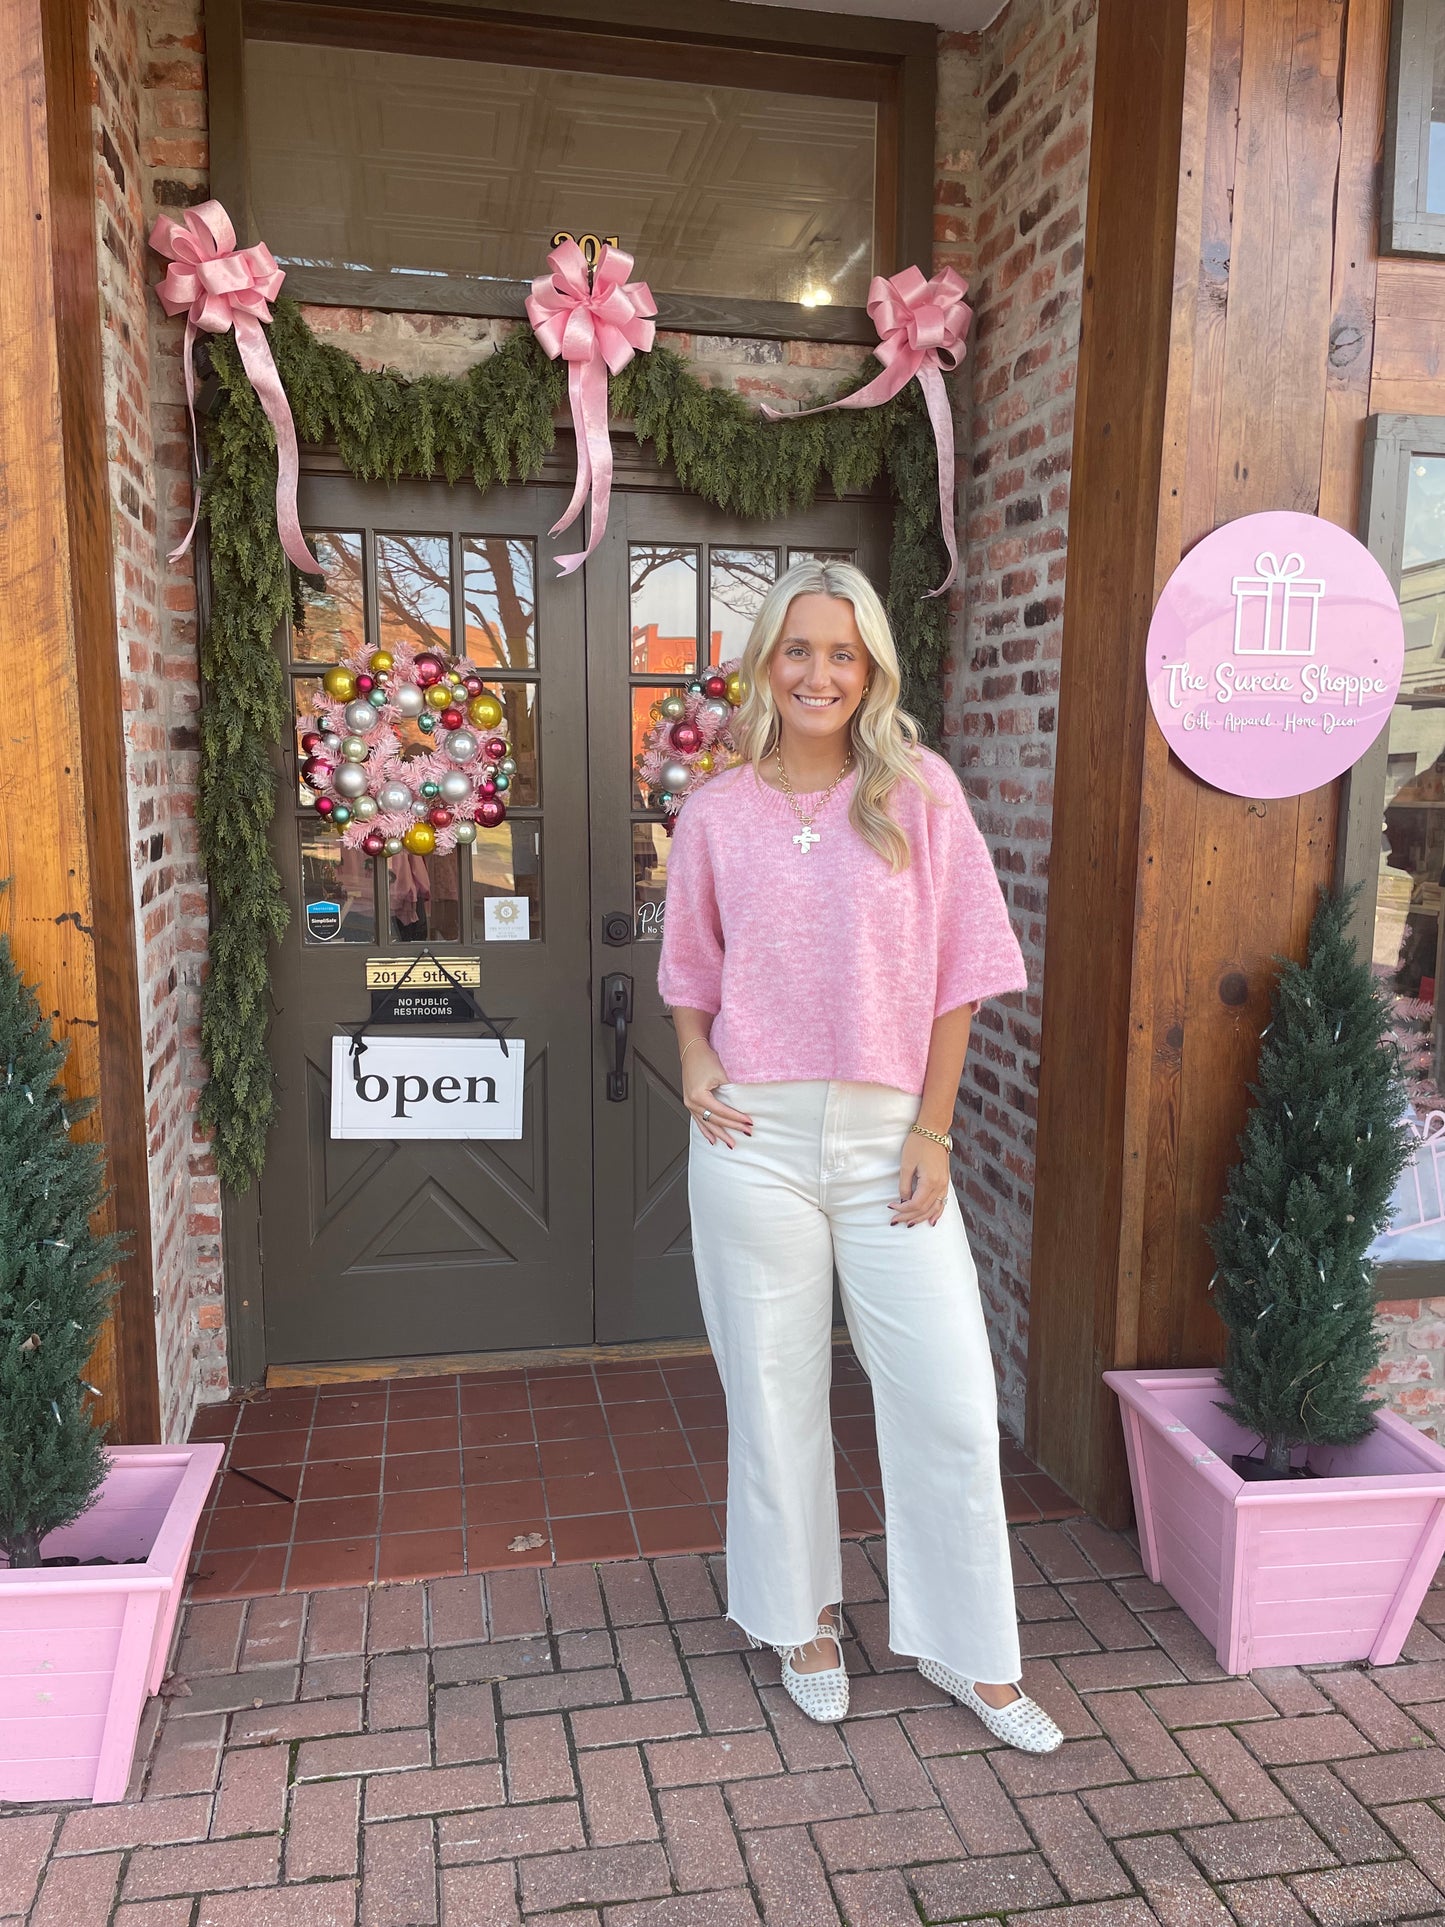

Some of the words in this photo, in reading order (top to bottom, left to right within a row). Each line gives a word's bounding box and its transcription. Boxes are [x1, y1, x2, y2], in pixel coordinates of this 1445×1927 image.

[1162, 662, 1209, 709] The
[1215, 662, 1295, 704] Surcie
[1300, 663, 1388, 707] Shoppe
[1182, 711, 1210, 731] Gift
[1223, 712, 1272, 733] Apparel
[1283, 713, 1318, 734] Home
[1321, 712, 1359, 735] Decor
[647, 926, 658, 934] No
[373, 971, 398, 984] 201
[423, 970, 448, 983] 9th
[453, 970, 473, 982] St.
[398, 998, 412, 1006] NO
[414, 997, 449, 1006] PUBLIC
[393, 1007, 453, 1016] RESTROOMS
[355, 1074, 500, 1119] open
